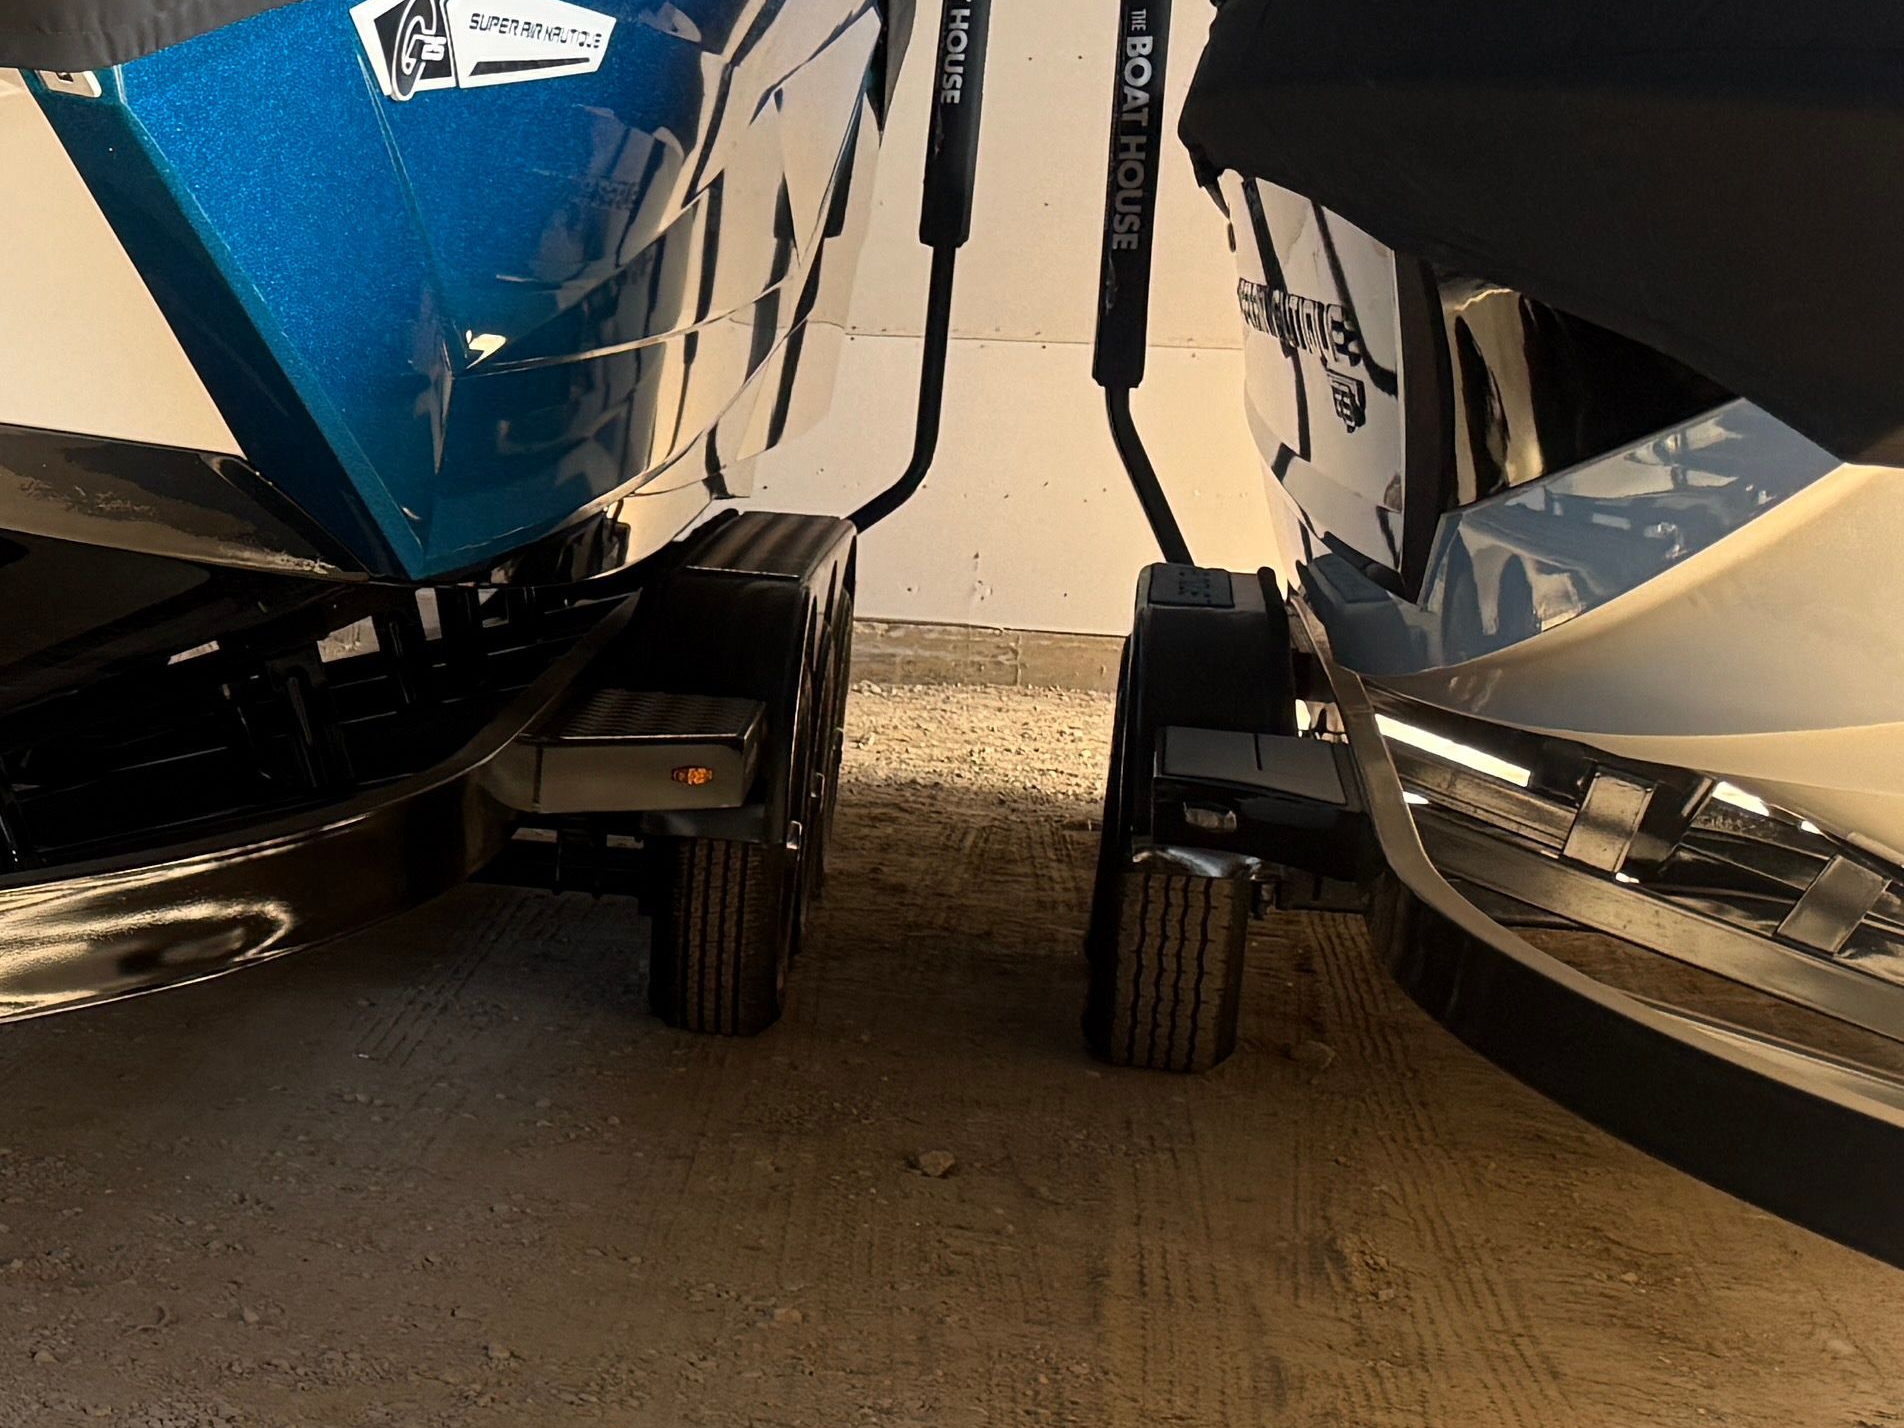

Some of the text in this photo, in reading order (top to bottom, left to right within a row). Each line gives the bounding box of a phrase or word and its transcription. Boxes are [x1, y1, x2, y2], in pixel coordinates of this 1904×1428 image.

[469, 13, 520, 37] SUPER
[941, 8, 971, 104] HOUSE
[1121, 35, 1153, 126] BOAT
[1112, 135, 1148, 250] HOUSE
